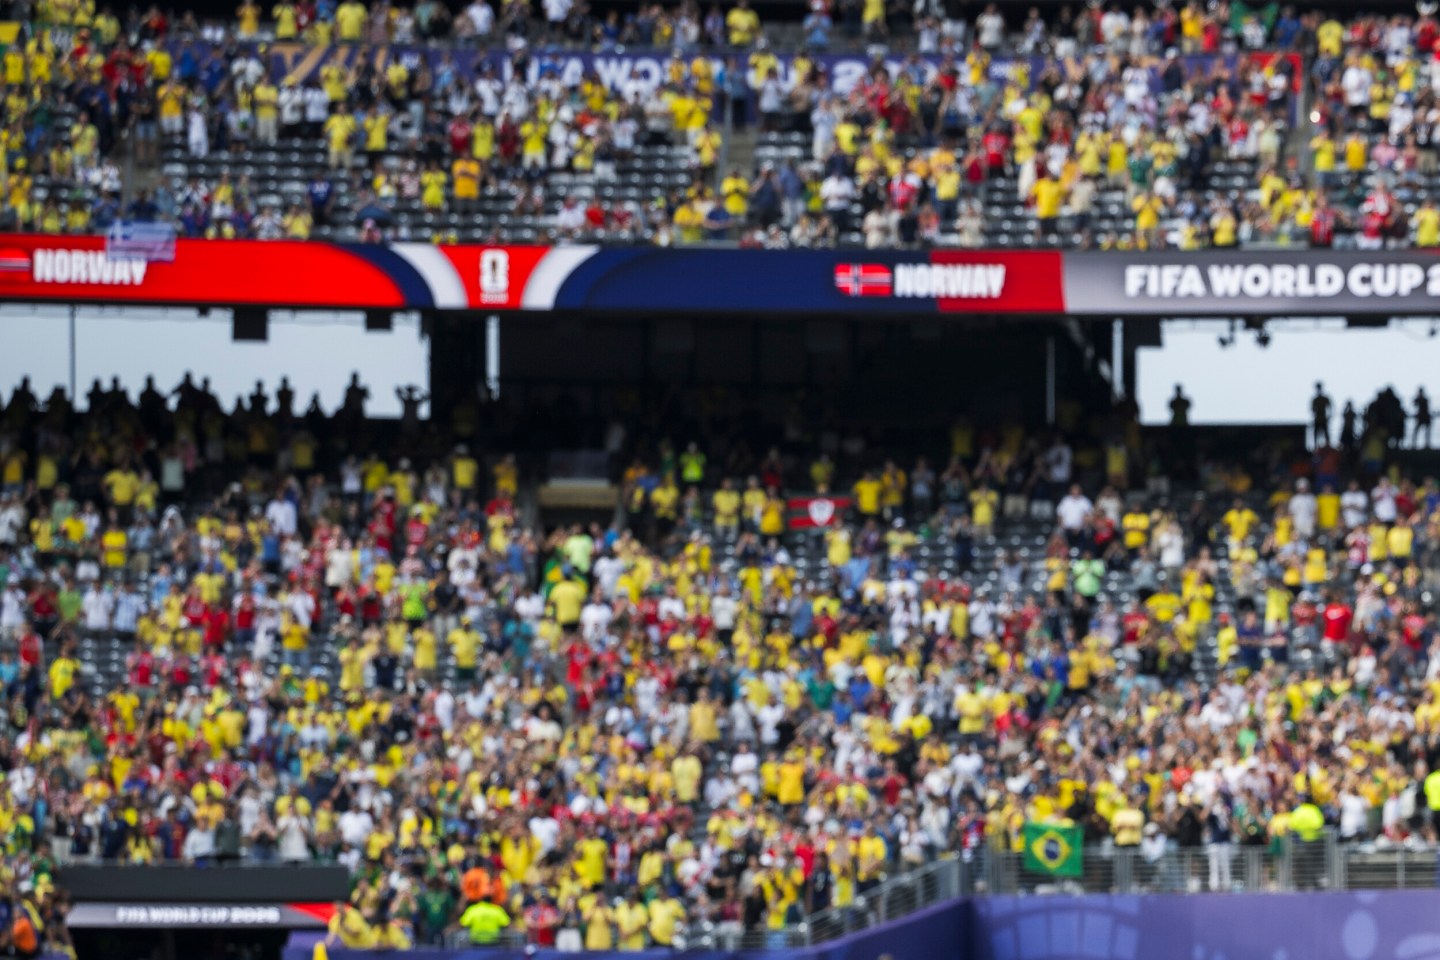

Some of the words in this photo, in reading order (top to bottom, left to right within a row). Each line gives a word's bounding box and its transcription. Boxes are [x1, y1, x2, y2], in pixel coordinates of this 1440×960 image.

[33, 248, 148, 285] NORWAY
[894, 263, 1006, 298] NORWAY
[1124, 264, 1207, 298] FIFA
[1208, 264, 1345, 298] WORLD
[1347, 263, 1424, 297] CUP
[116, 906, 149, 923] FIFA
[150, 906, 200, 924] WORLD
[201, 906, 230, 924] CUP
